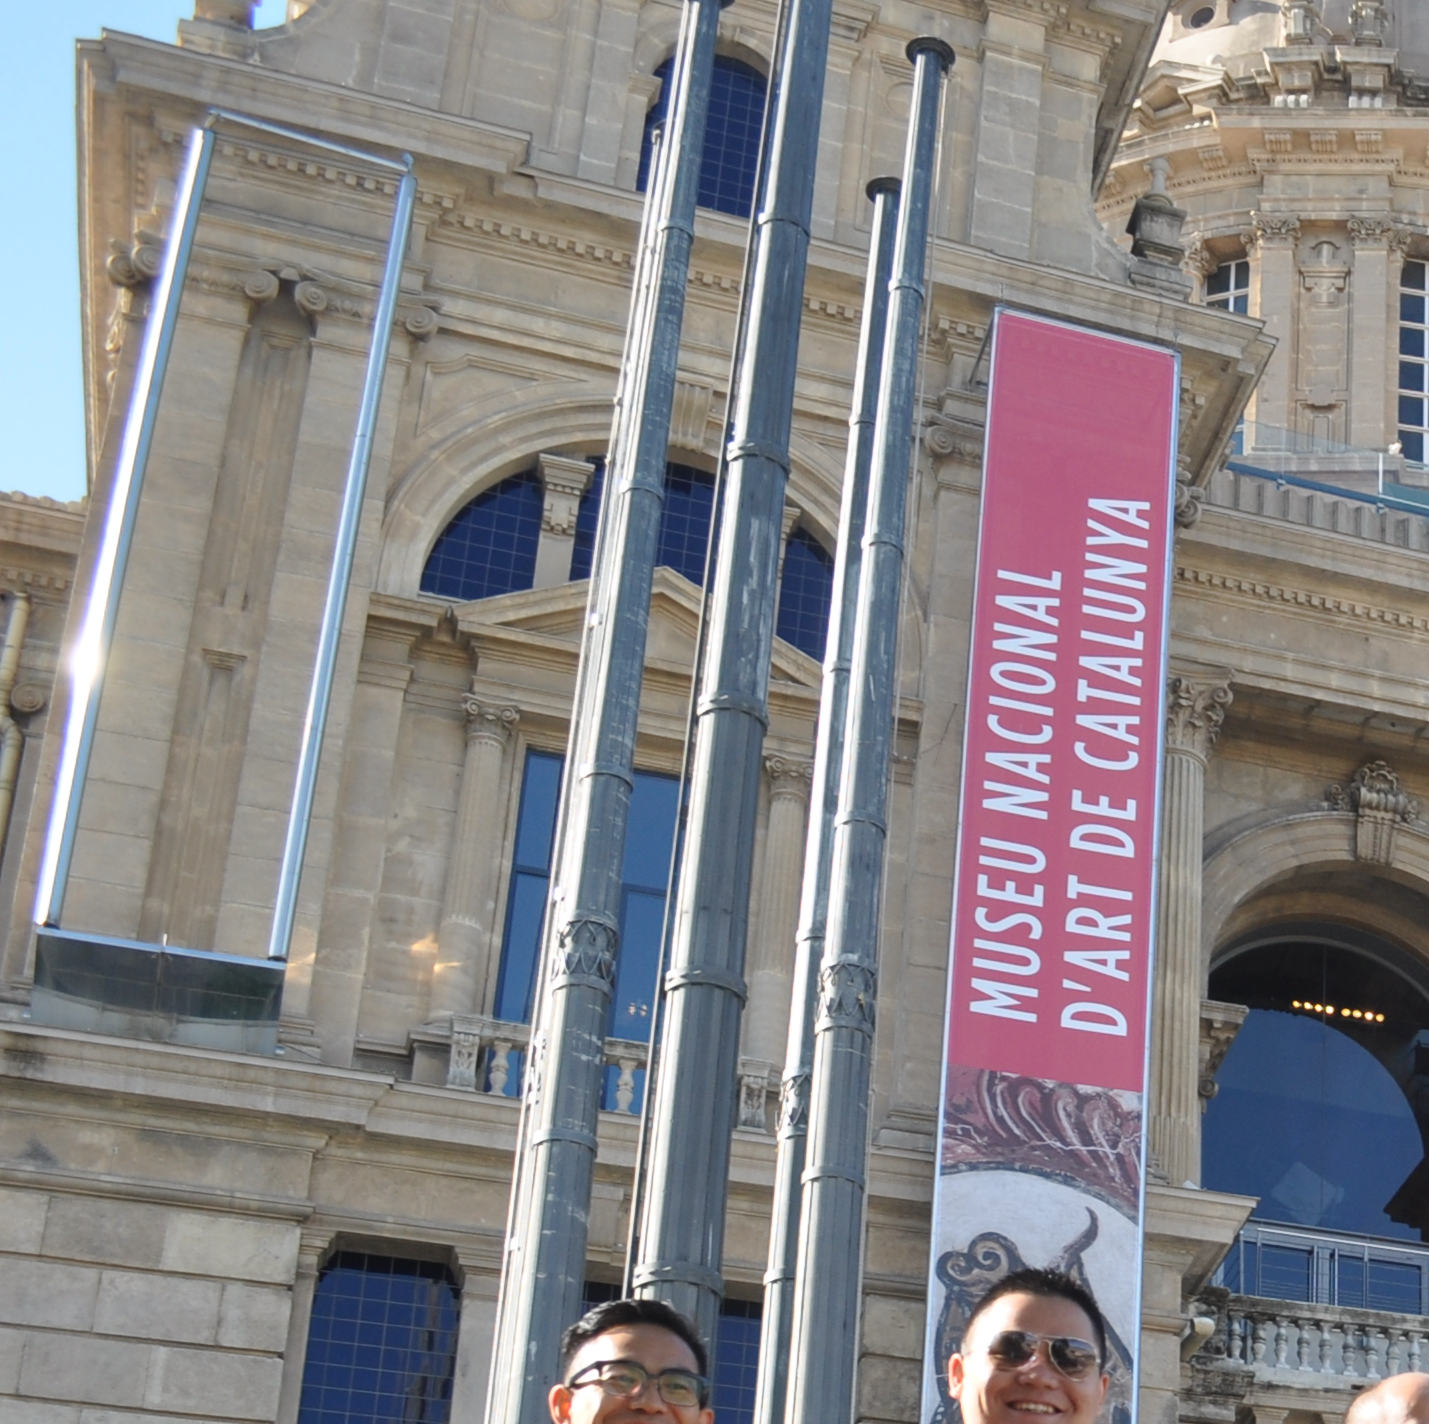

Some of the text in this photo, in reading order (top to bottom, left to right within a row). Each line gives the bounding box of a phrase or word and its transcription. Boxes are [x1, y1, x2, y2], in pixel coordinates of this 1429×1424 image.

[969, 569, 1062, 1023] MUSEU NACIONAL
[1060, 498, 1151, 1037] D'ART DE CATALUNYA
